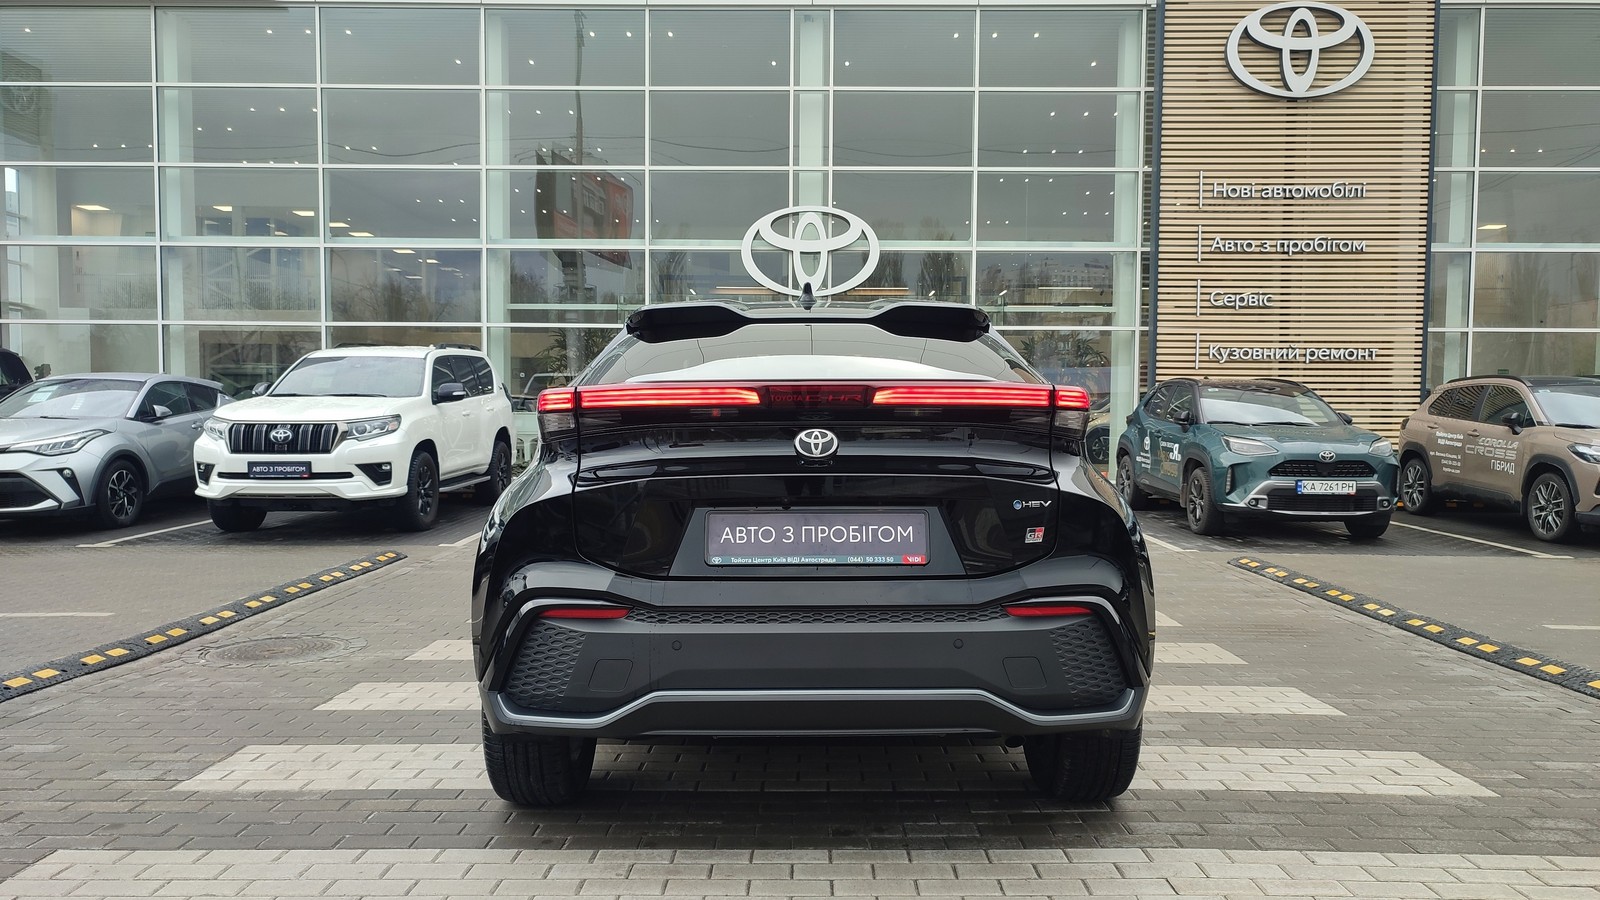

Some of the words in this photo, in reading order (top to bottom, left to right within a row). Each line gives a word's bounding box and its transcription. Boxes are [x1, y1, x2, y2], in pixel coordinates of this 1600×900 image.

[1212, 181, 1256, 198] Нові
[1261, 181, 1367, 198] автомобілі
[1211, 236, 1255, 252] Авто
[1260, 240, 1270, 252] з
[1276, 236, 1367, 256] пробігом
[1210, 290, 1274, 311] Сервіс
[1208, 343, 1300, 364] Кузовний
[1305, 347, 1379, 364] ремонт
[770, 394, 803, 402] TOYOTA
[805, 394, 863, 402] C-HR
[1478, 437, 1519, 450] COROLLA
[1465, 444, 1517, 460] CROSS
[1302, 482, 1317, 491] KA
[1319, 482, 1339, 491] 7261
[1341, 482, 1354, 492] PH
[1022, 500, 1052, 508] HEV
[720, 526, 776, 543] АВТО
[782, 526, 794, 543] З
[801, 525, 913, 543] ПРОБІГОМ
[800, 556, 836, 564] Автострада
